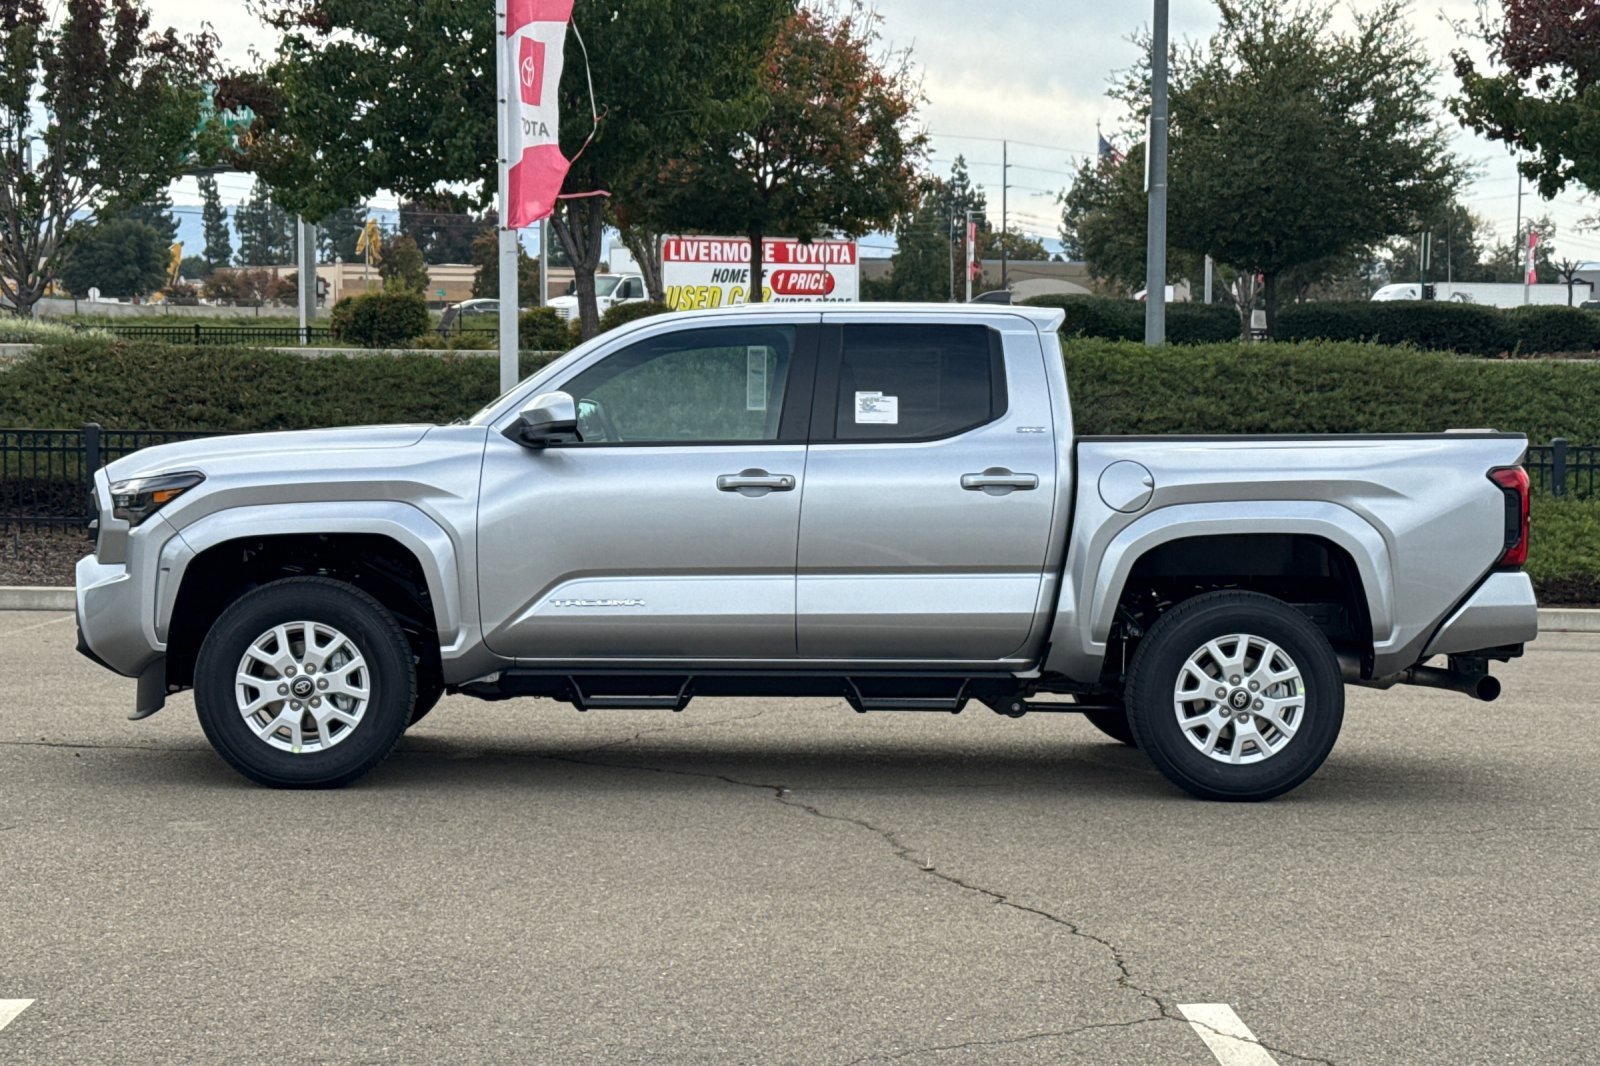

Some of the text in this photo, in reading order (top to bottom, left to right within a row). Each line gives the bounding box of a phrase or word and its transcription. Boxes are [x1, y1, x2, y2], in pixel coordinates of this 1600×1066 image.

[669, 241, 851, 264] LIVERMOE TOYOTA
[711, 268, 749, 283] HOME
[777, 272, 785, 290] 1
[665, 285, 723, 311] USED
[549, 599, 646, 607] TACOMA
